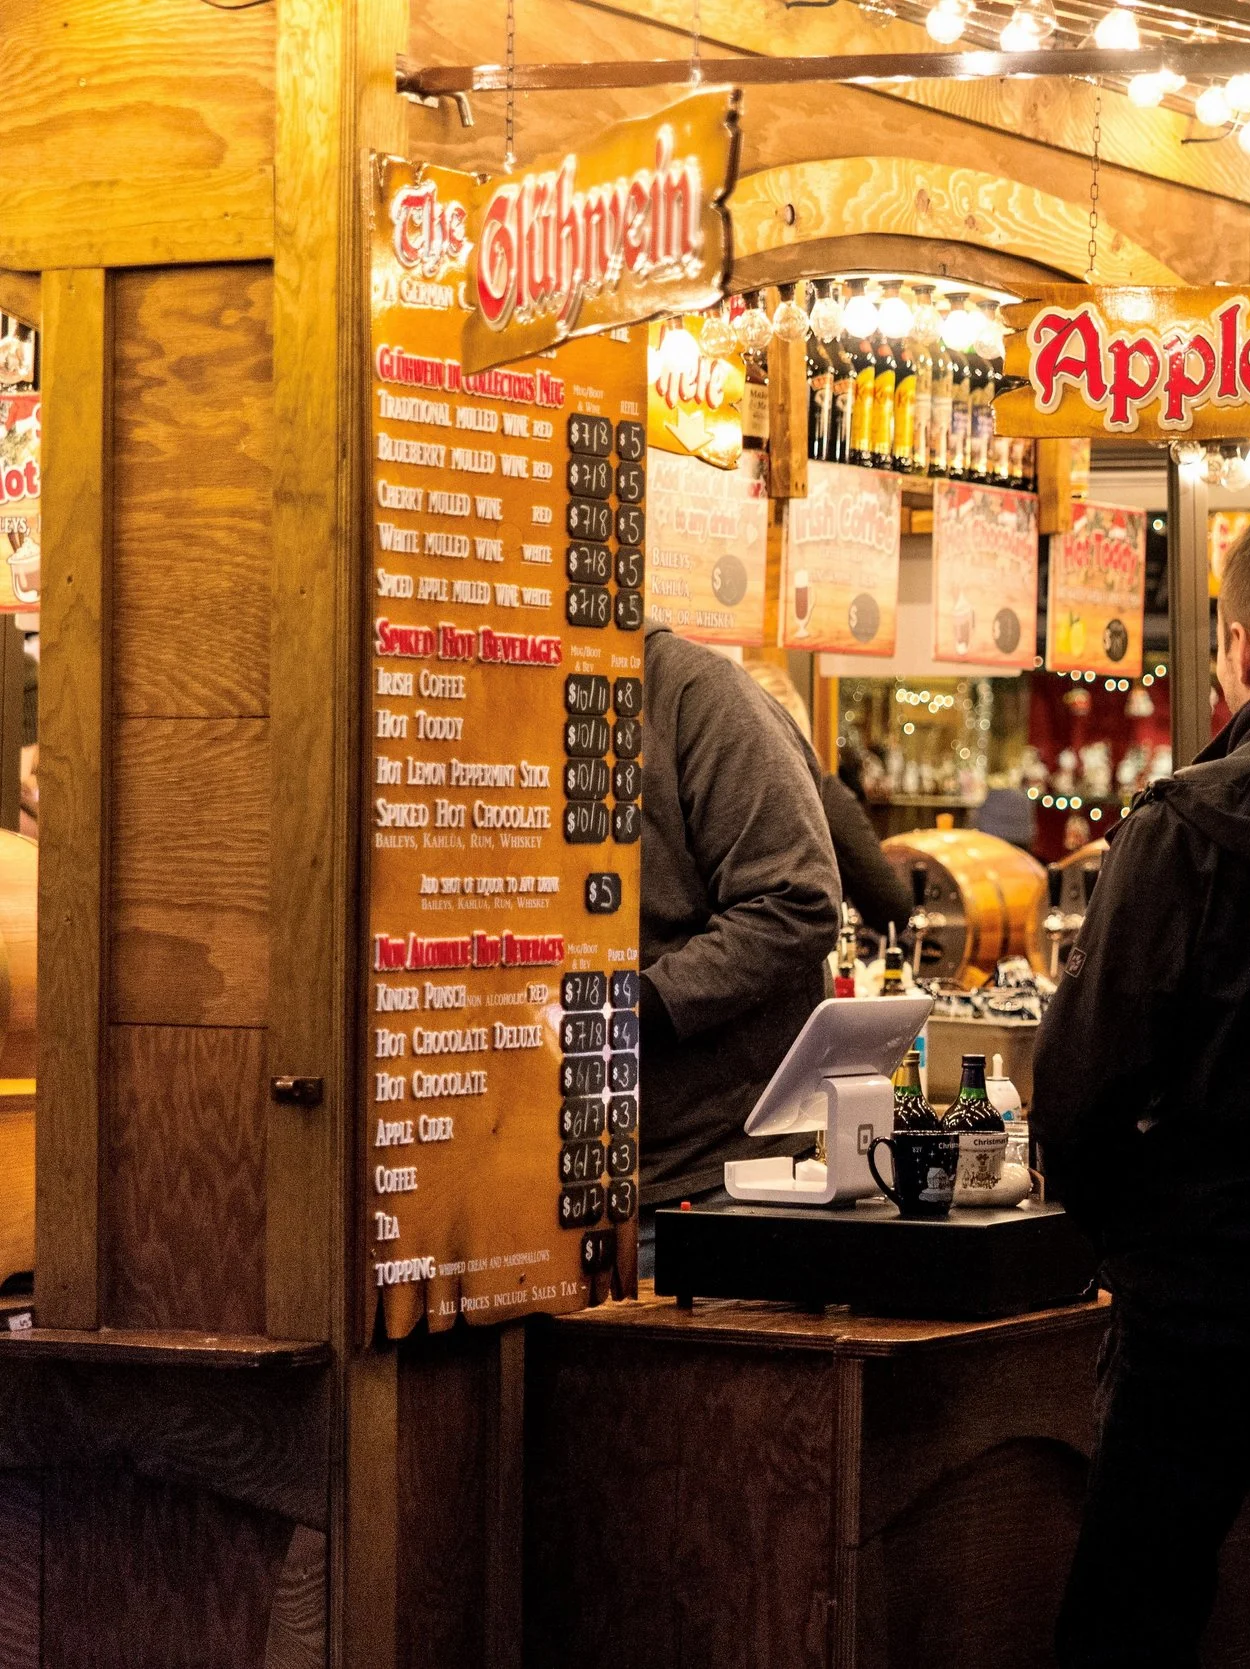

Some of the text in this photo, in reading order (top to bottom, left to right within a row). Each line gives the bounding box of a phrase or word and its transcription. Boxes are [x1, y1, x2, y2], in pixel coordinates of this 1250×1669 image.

[392, 180, 471, 277] The
[477, 124, 704, 332] Glühwein
[400, 278, 454, 308] GERMAN
[376, 344, 445, 388] GLÜHWEIN
[444, 358, 462, 392] IN
[536, 368, 566, 409] MUG
[378, 389, 553, 438] TRADITIONAL MULLED WINE RED
[620, 400, 639, 416] REFILL
[378, 432, 553, 479] BLUEBERRY MULLED WINE RED
[0, 457, 41, 505] ot
[378, 480, 553, 523] CHERRY MULLED WINE RED
[377, 523, 552, 563] WHITE MULLED WINE WHITE
[377, 568, 552, 608] SPICED APPLE MULLED WINE WHITE
[651, 604, 672, 624] RUM
[376, 617, 562, 667] SPIKED HOT BEVERAGES
[611, 654, 628, 668] PAPER
[630, 655, 641, 669] CUP
[377, 667, 466, 699] IRISH COFFEE
[376, 709, 464, 740] HOT TODDY
[376, 756, 550, 788] HOT LEMON PEPPERMINT STICK
[376, 798, 551, 829] SPIKED HOT CHOCOLATE
[375, 833, 418, 850] BAILEYS,
[470, 833, 494, 850] RUM,
[500, 833, 542, 849] WHISKEY
[420, 874, 560, 896] ADD SHOT OF LIQUOR TO ANY DRINK
[494, 896, 513, 910] RUM,
[516, 896, 550, 909] WHISKEY
[501, 929, 565, 967] BEVERAGES
[607, 948, 625, 961] PAPER
[626, 947, 638, 960] CUP
[376, 983, 420, 1011] KINDER
[424, 982, 467, 1010] PUNSCH
[528, 984, 548, 1004] RED
[376, 1021, 543, 1058] HOT CHOCOLATE DELUXE
[375, 1069, 488, 1102] HOT CHOCOLATE
[612, 1100, 630, 1128] $3
[375, 1114, 454, 1147] APPLE CIDER
[611, 1145, 630, 1172] $3
[375, 1165, 418, 1194] COFFEE
[375, 1211, 400, 1241] TEA
[375, 1249, 550, 1287] TOPPING WHIPPED CREAM AND MARSHMALLOWS
[439, 1281, 577, 1316] ALL PRICES INCLUDE SALES TAX
